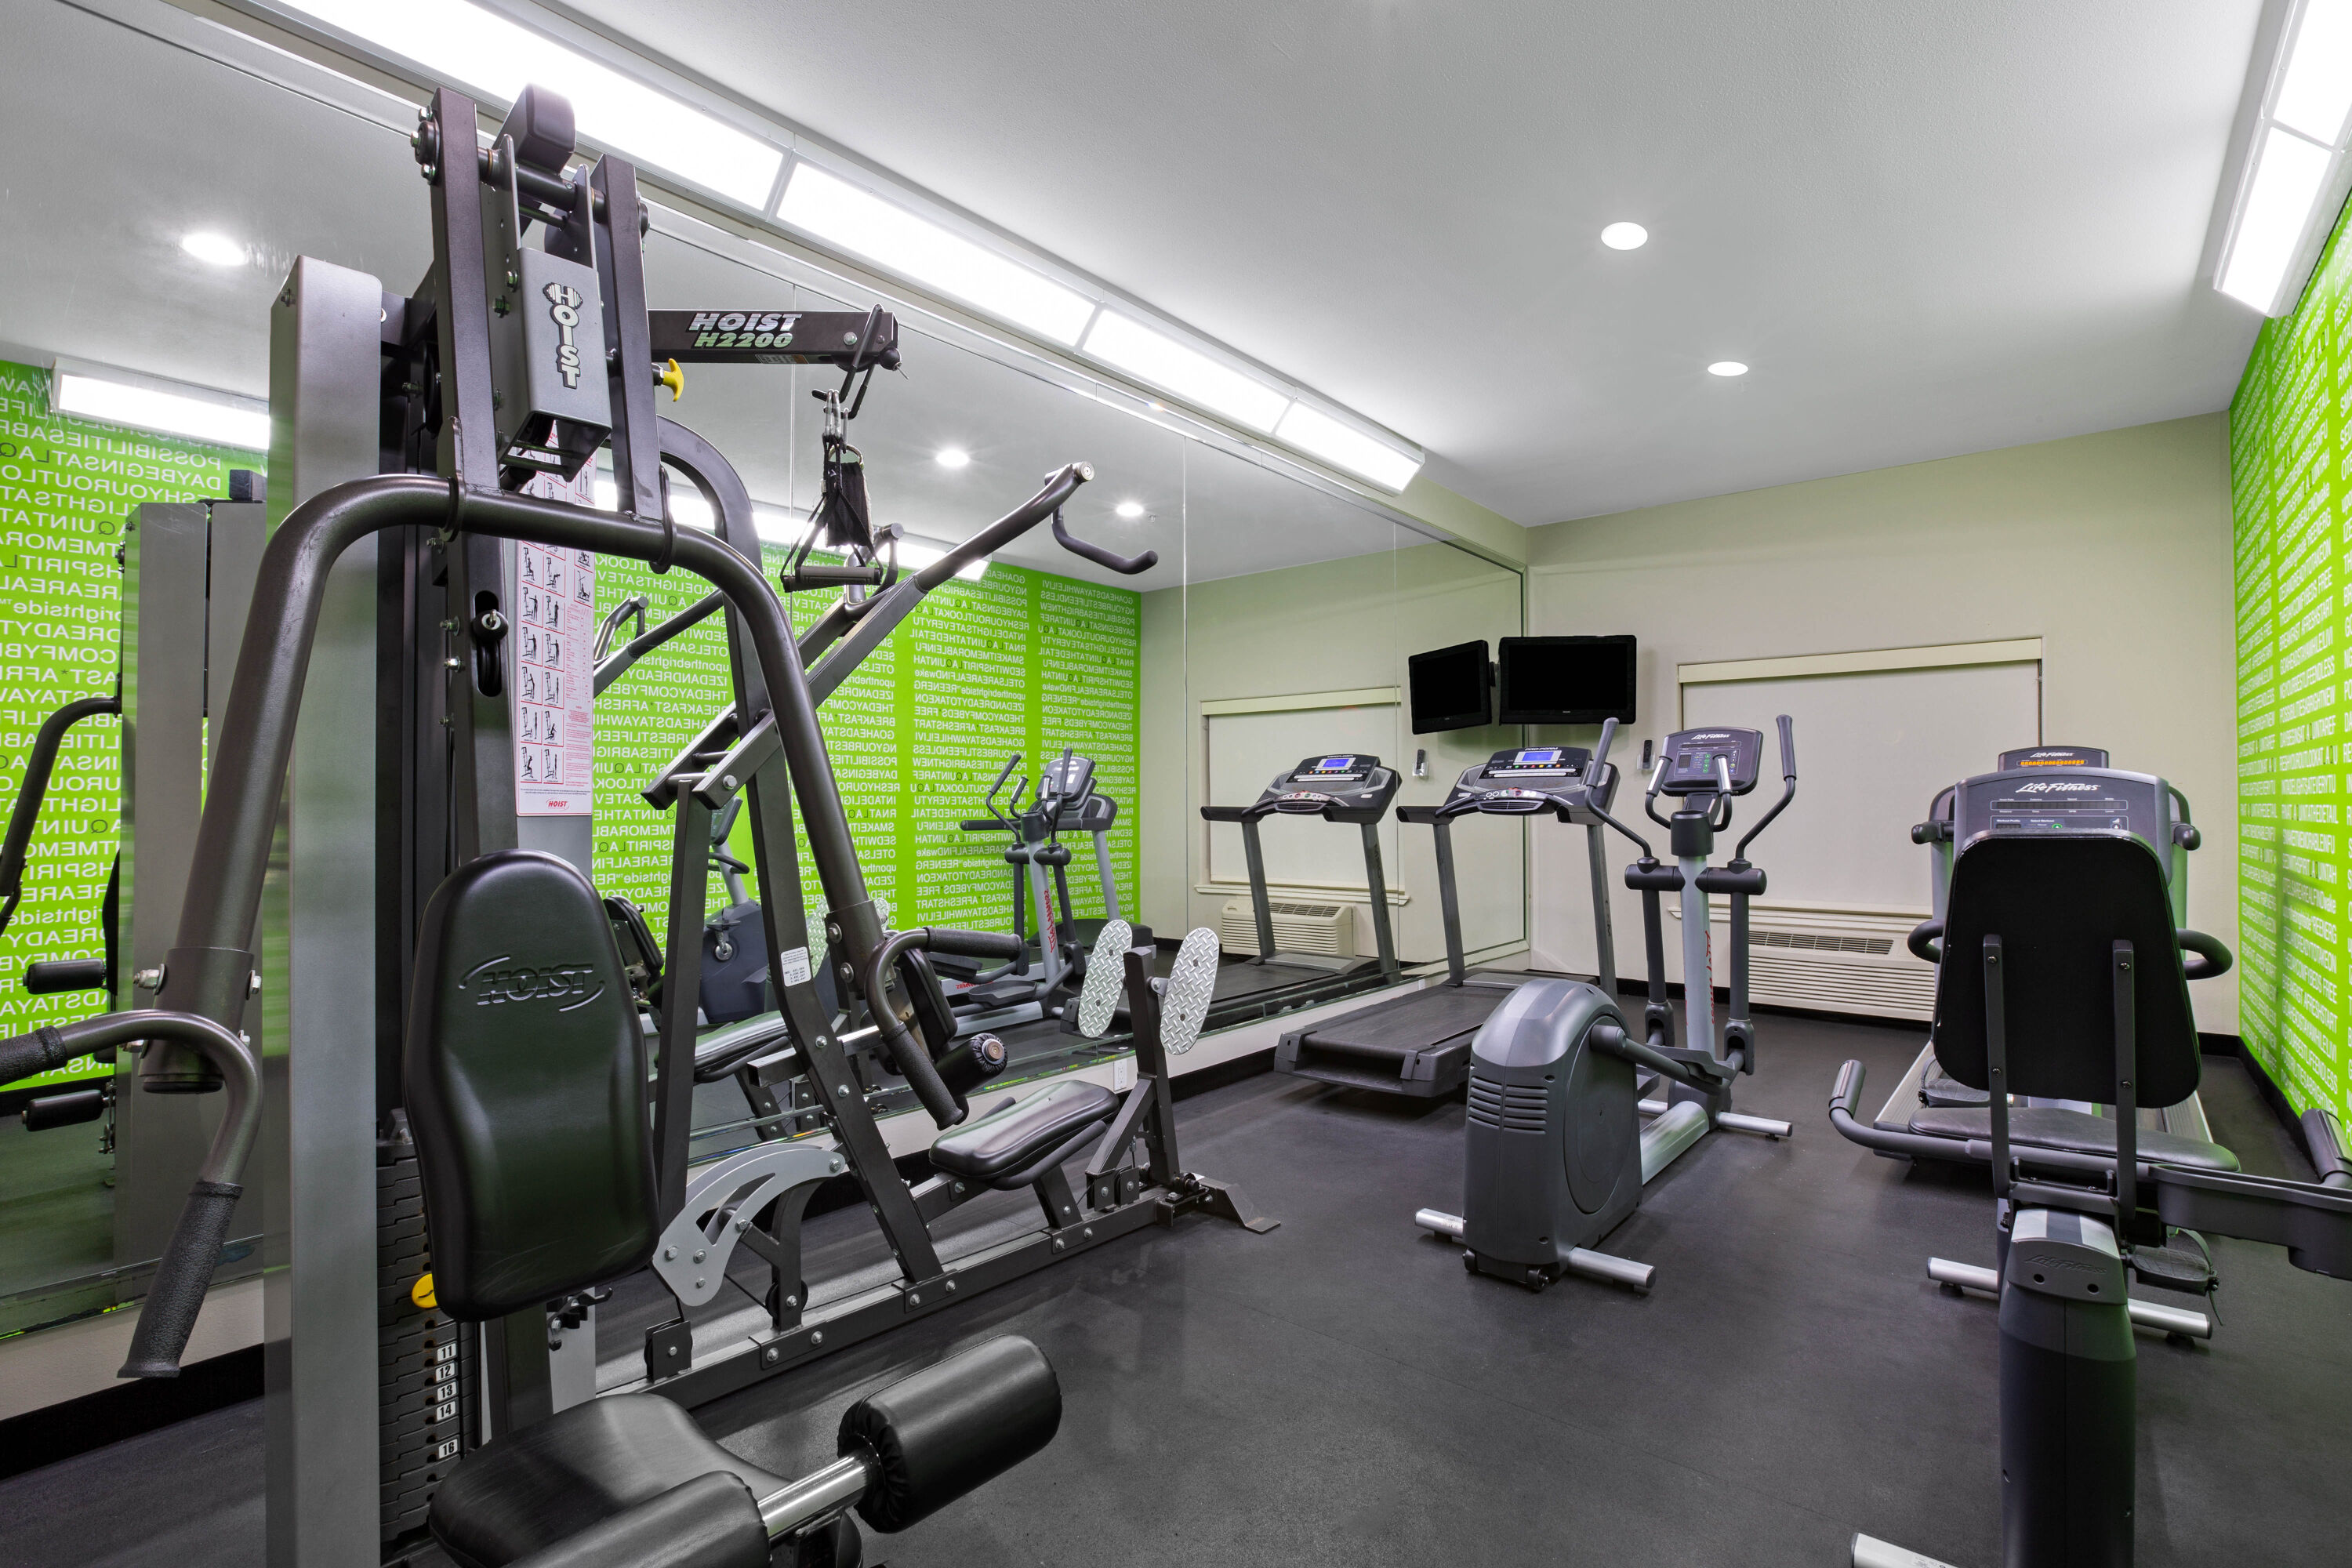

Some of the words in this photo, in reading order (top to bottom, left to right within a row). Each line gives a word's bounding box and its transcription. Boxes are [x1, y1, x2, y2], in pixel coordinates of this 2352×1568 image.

[687, 313, 802, 332] HOIST
[543, 282, 583, 389] HOIST
[692, 332, 793, 349] H2200
[477, 964, 593, 1005] HOIST
[441, 1346, 452, 1359] 11
[440, 1365, 451, 1378] 12
[441, 1385, 452, 1398] 13
[440, 1404, 452, 1417] 14
[443, 1442, 454, 1455] 16
